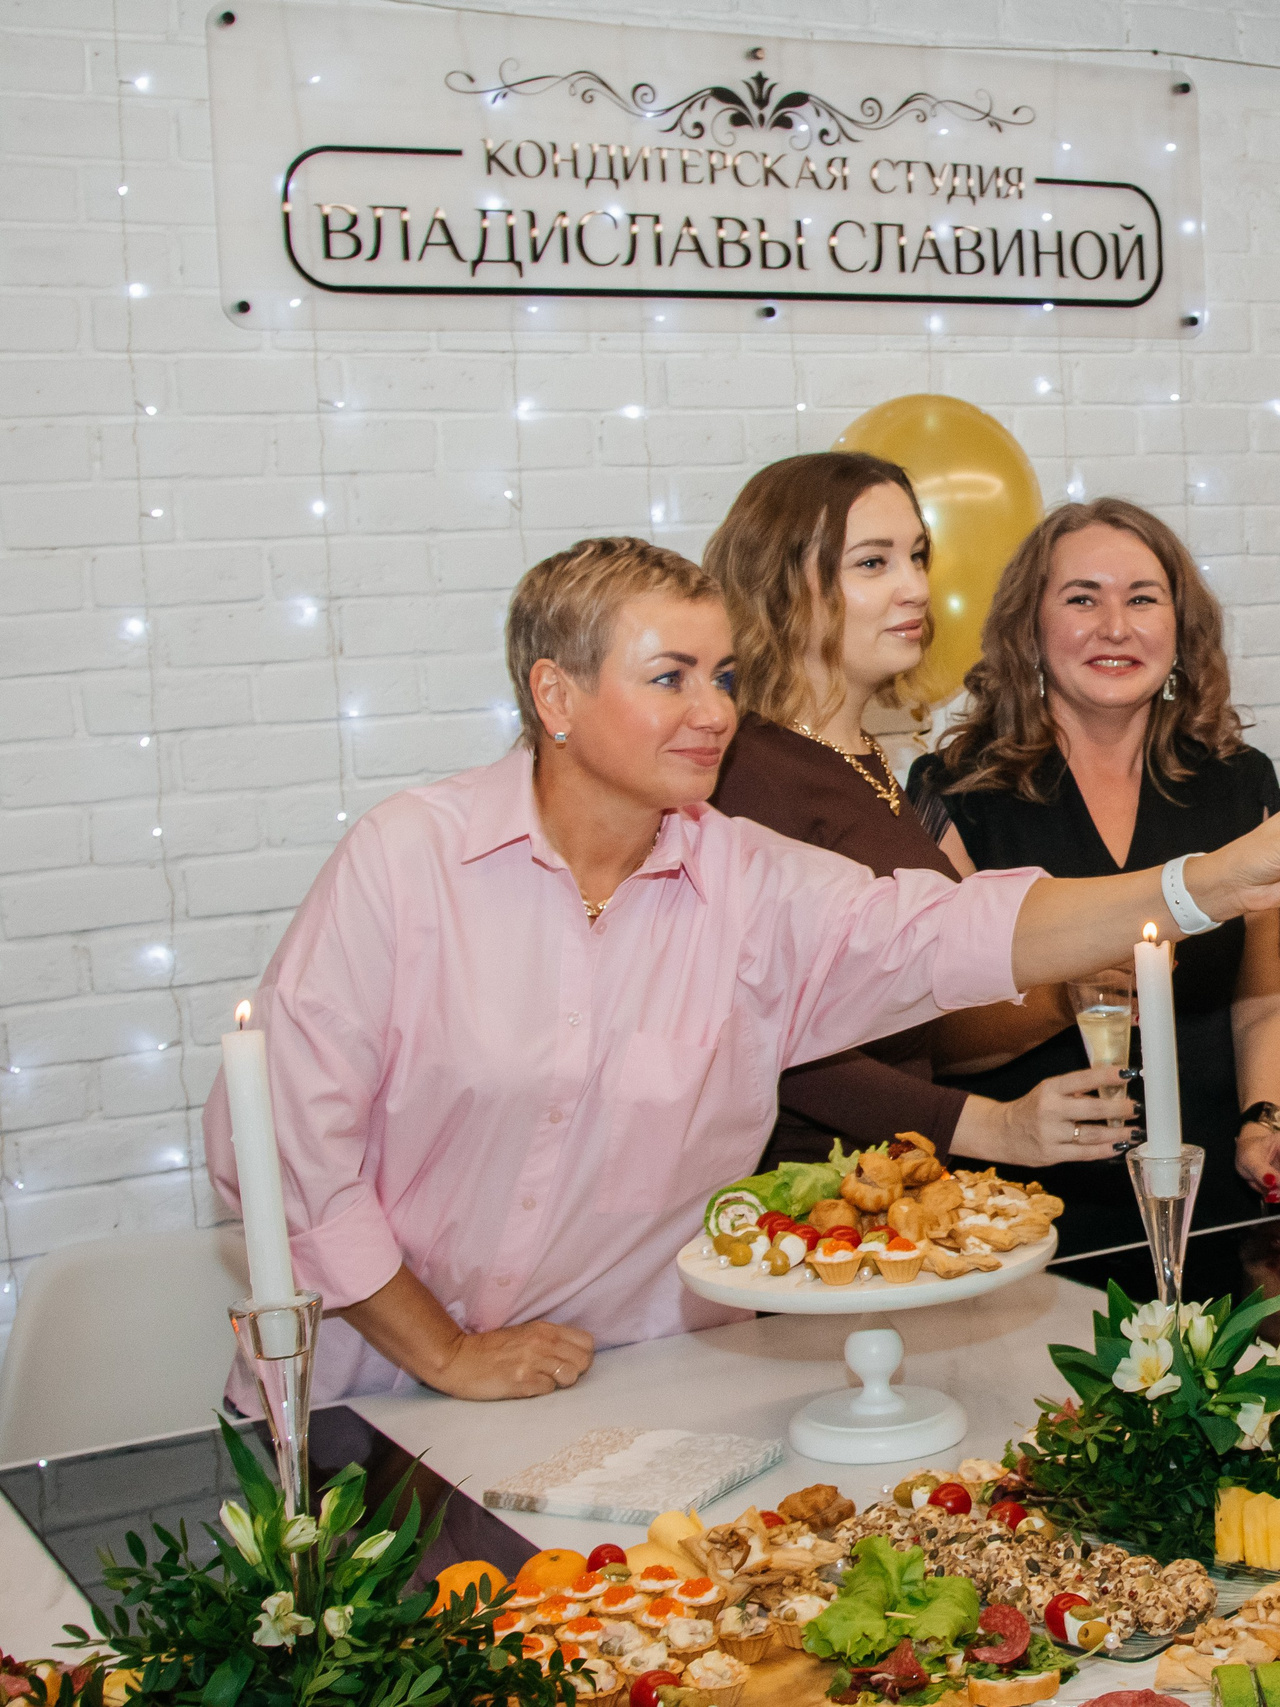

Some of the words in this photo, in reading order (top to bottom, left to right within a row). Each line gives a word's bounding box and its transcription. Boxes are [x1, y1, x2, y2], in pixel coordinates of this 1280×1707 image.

[482, 138, 848, 191] КОНДИТЕРСКАЯ
[870, 158, 1024, 205] СТУДИЯ
[314, 203, 811, 278] ВЛАДИСЛАВЫ
[829, 220, 1146, 281] СЛАВИНОЙ
